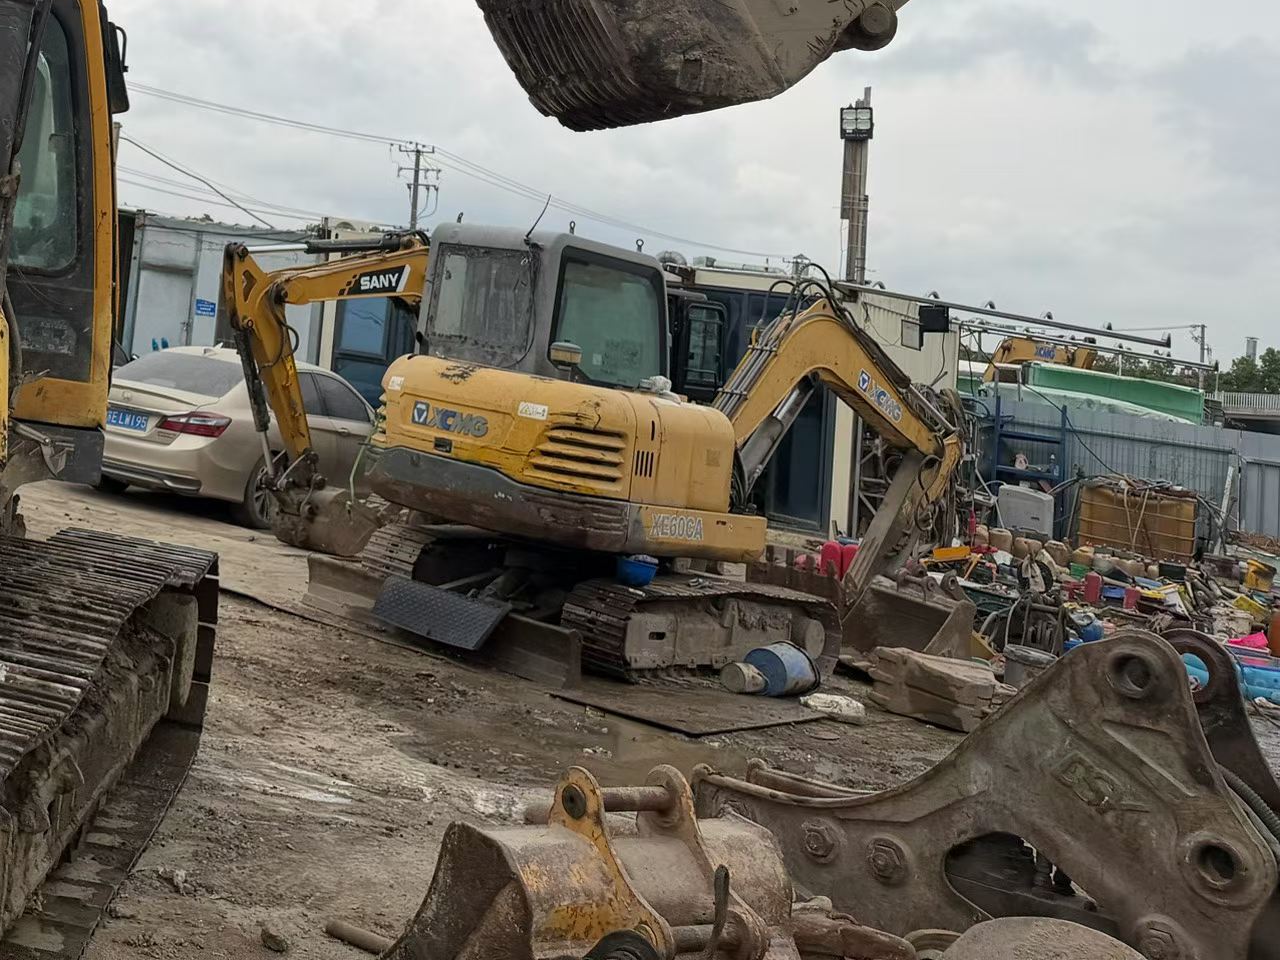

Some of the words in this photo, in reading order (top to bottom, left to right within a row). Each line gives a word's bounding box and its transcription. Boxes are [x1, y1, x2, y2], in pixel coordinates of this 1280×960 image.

[360, 273, 399, 290] SANY
[868, 380, 902, 423] XCMG
[428, 406, 488, 438] XCMG
[650, 512, 704, 540] XE60CA
